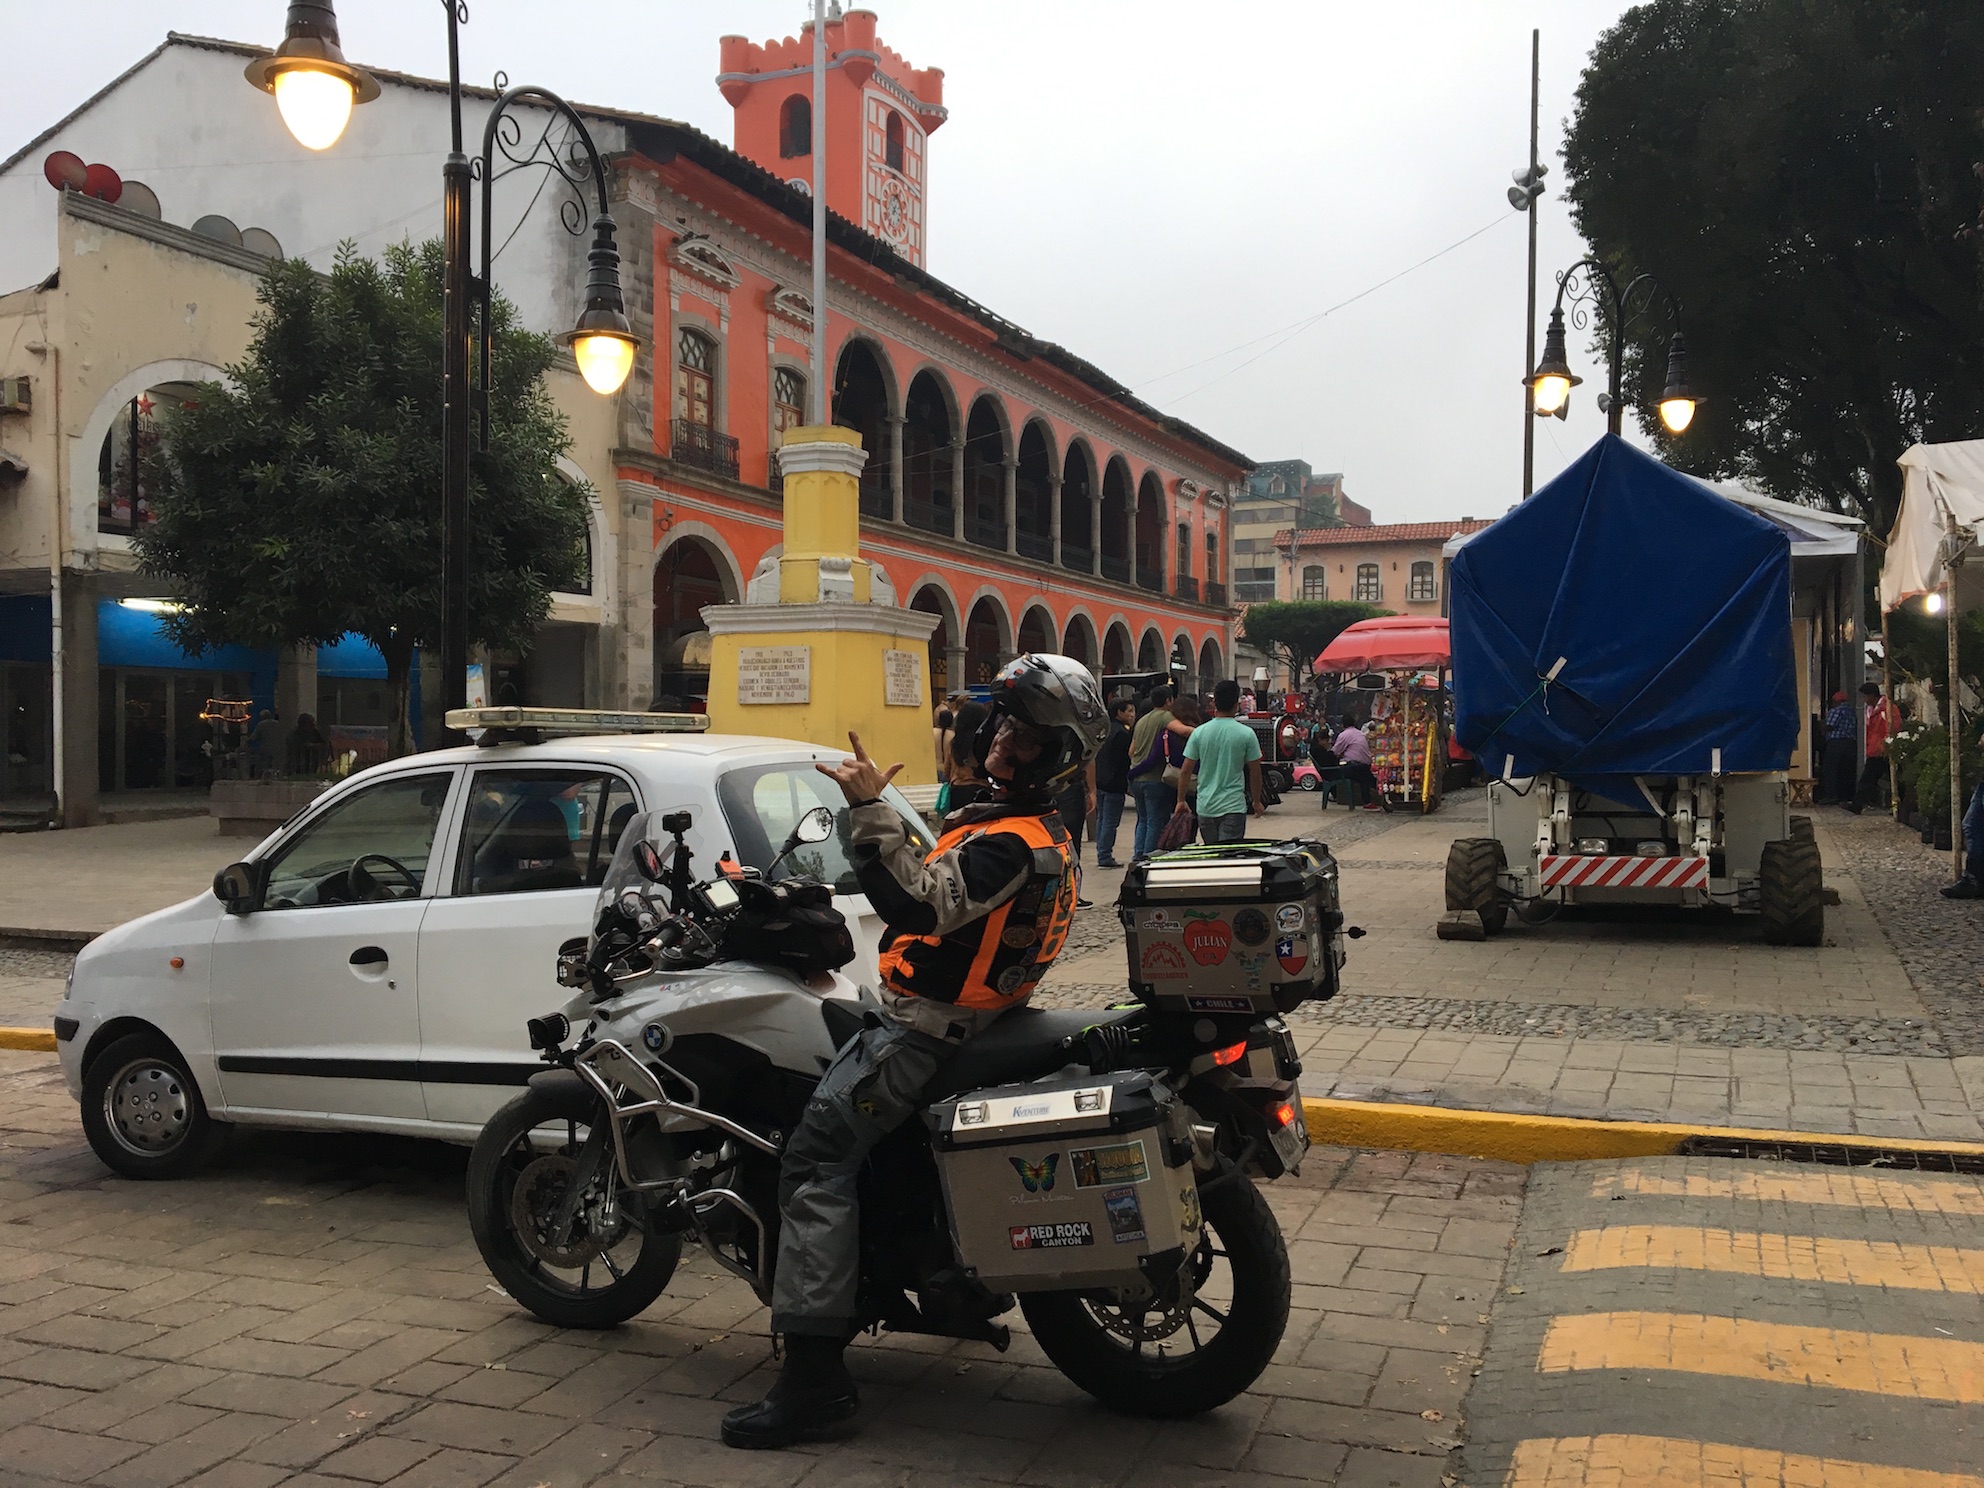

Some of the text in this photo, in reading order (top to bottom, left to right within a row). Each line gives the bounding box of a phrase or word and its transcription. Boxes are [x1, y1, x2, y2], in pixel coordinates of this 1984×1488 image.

[1193, 935, 1228, 951] JULIAN
[1206, 999, 1235, 1009] CHILE
[1098, 1147, 1144, 1169] SEQUOIA
[1030, 1222, 1091, 1240] RED ROCK
[1041, 1236, 1082, 1248] CANYON
